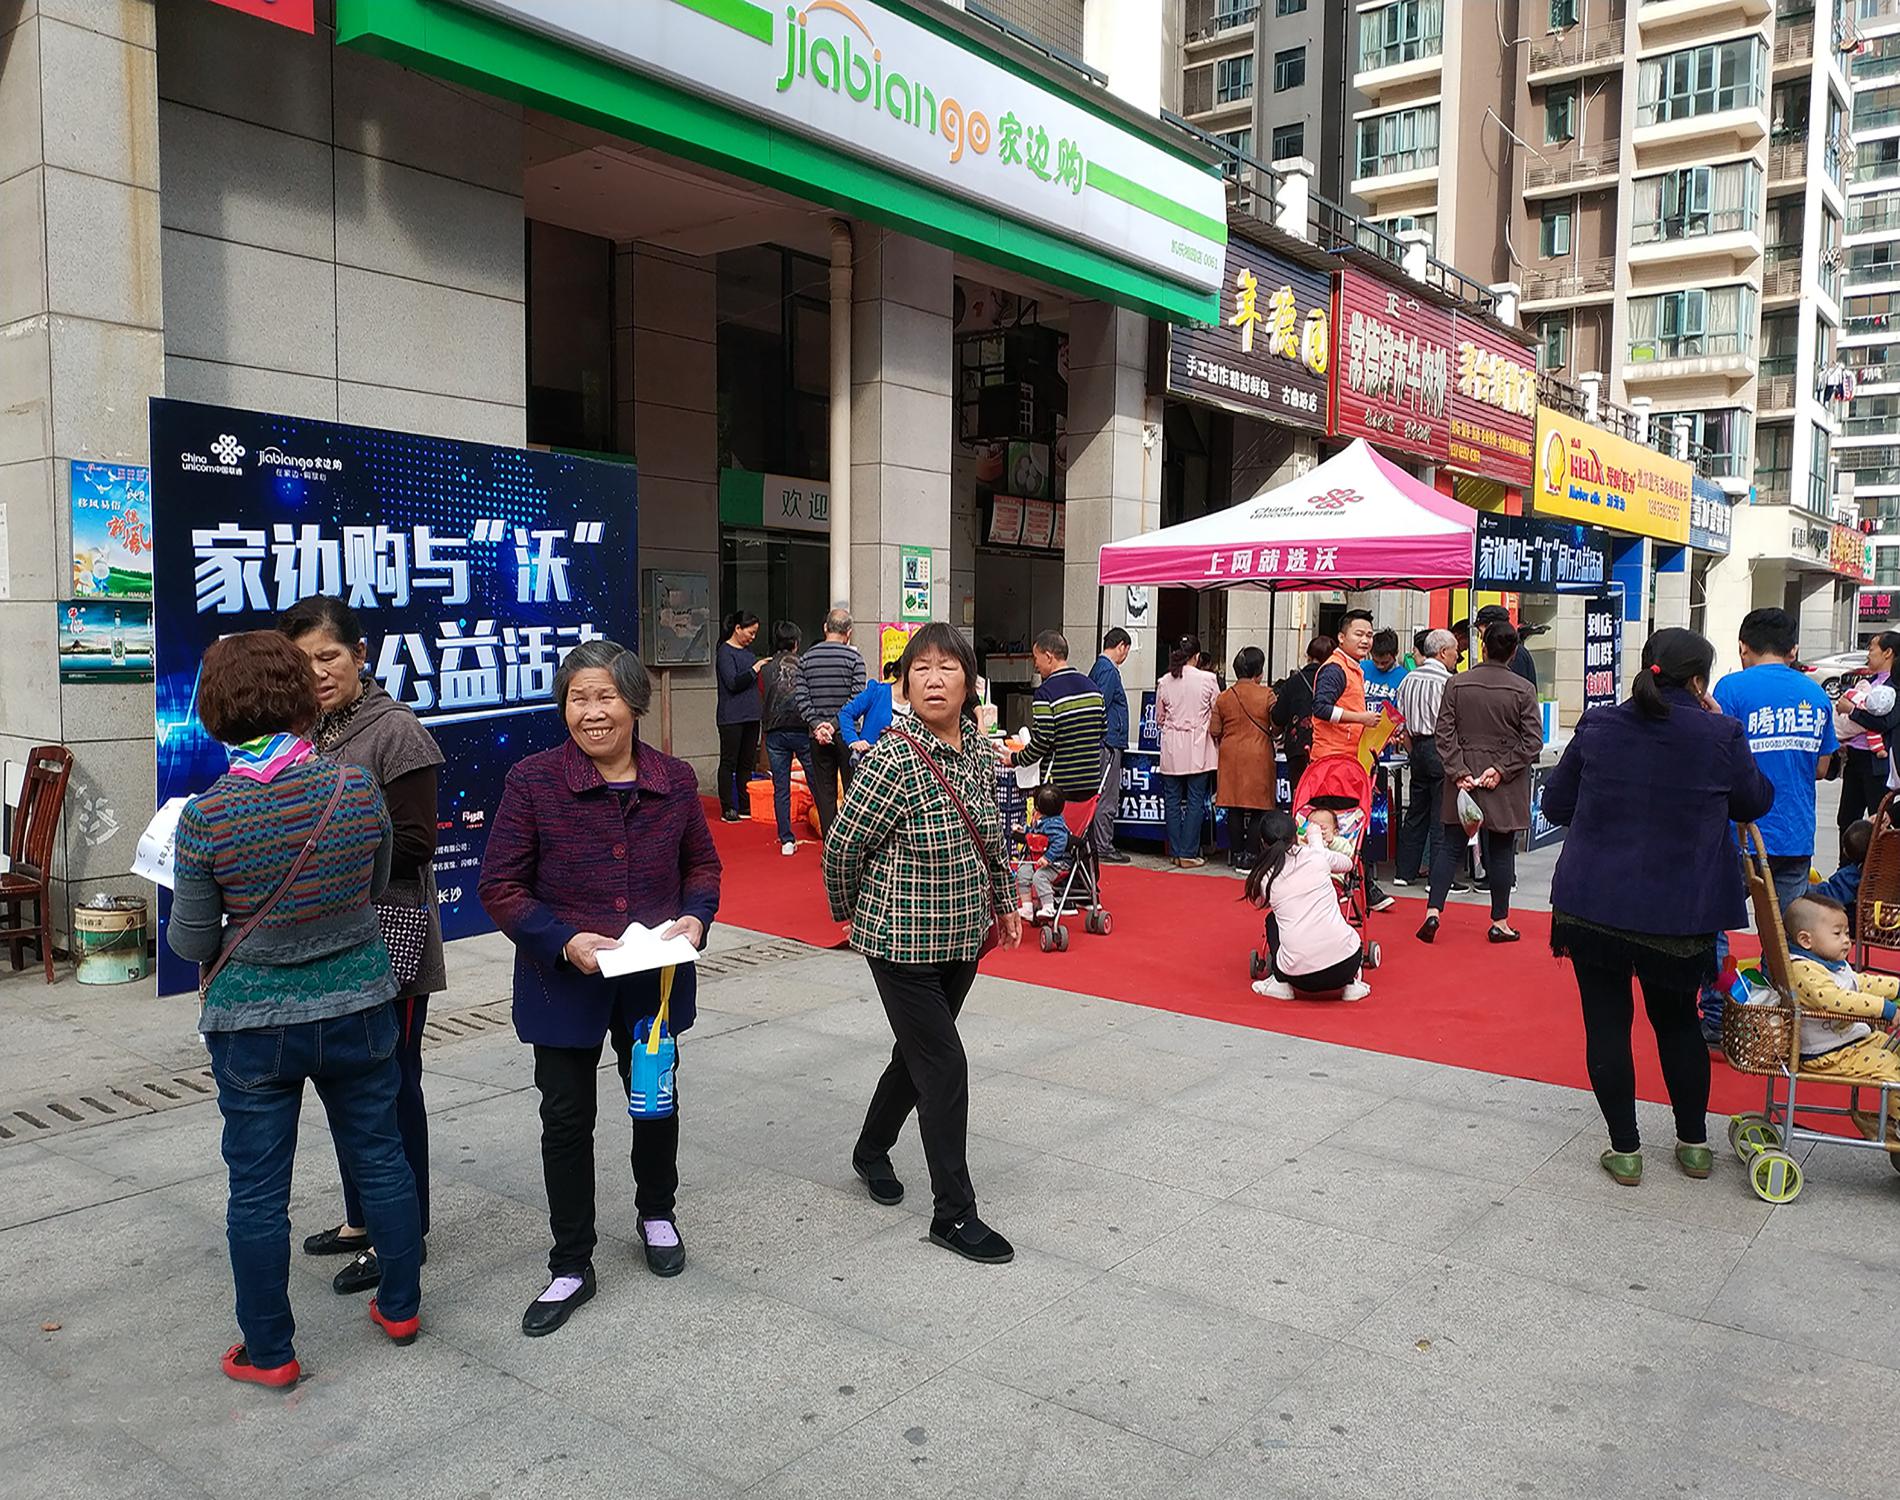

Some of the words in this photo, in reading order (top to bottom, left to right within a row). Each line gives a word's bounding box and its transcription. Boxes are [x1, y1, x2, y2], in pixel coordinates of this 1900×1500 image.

[776, 4, 991, 163] jiabiango
[998, 110, 1085, 195] 家边购
[1348, 310, 1448, 419] 常德津市牛肉粉
[181, 452, 207, 464] China
[1570, 449, 1605, 486] HELIX
[781, 488, 828, 521] 欢迎
[1204, 546, 1340, 575] 上网就选沃
[1587, 612, 1613, 637] 到店
[1586, 641, 1613, 667] 加群
[1585, 670, 1615, 696] 有好礼
[437, 886, 462, 905] 长沙
